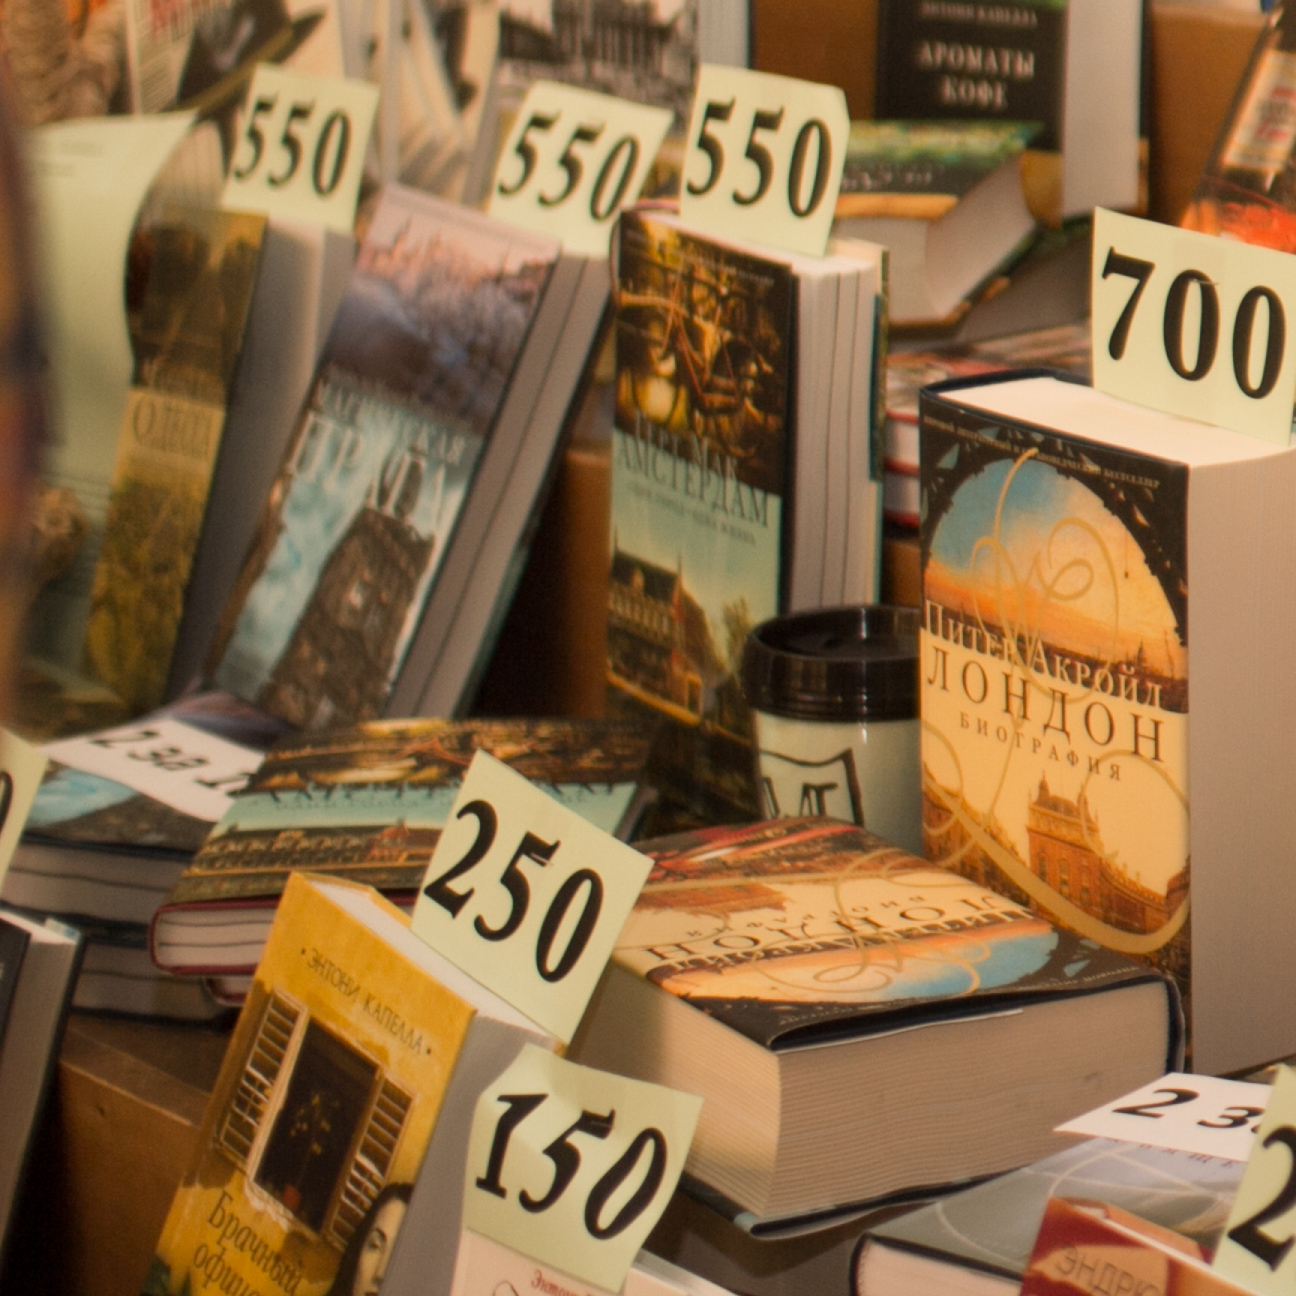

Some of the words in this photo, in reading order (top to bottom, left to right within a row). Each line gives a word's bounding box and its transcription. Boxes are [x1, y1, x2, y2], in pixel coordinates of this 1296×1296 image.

[917, 40, 1036, 80] АРОМАТЫ
[233, 92, 353, 198] 550
[497, 109, 642, 223] 550
[686, 95, 833, 219] 550
[1101, 245, 1287, 400] 700
[926, 598, 1017, 668] ПИТЕР
[1027, 638, 1164, 710] АКРОЙД
[926, 645, 1165, 764] ЛОНДОН
[959, 710, 1122, 782] БИОГРАФИЯ
[423, 798, 605, 984] 250
[306, 947, 361, 999] ЭНТОНИ
[362, 992, 424, 1055] КАПЕЛЛА
[476, 1093, 669, 1240] 150
[207, 1189, 301, 1296] Брачный
